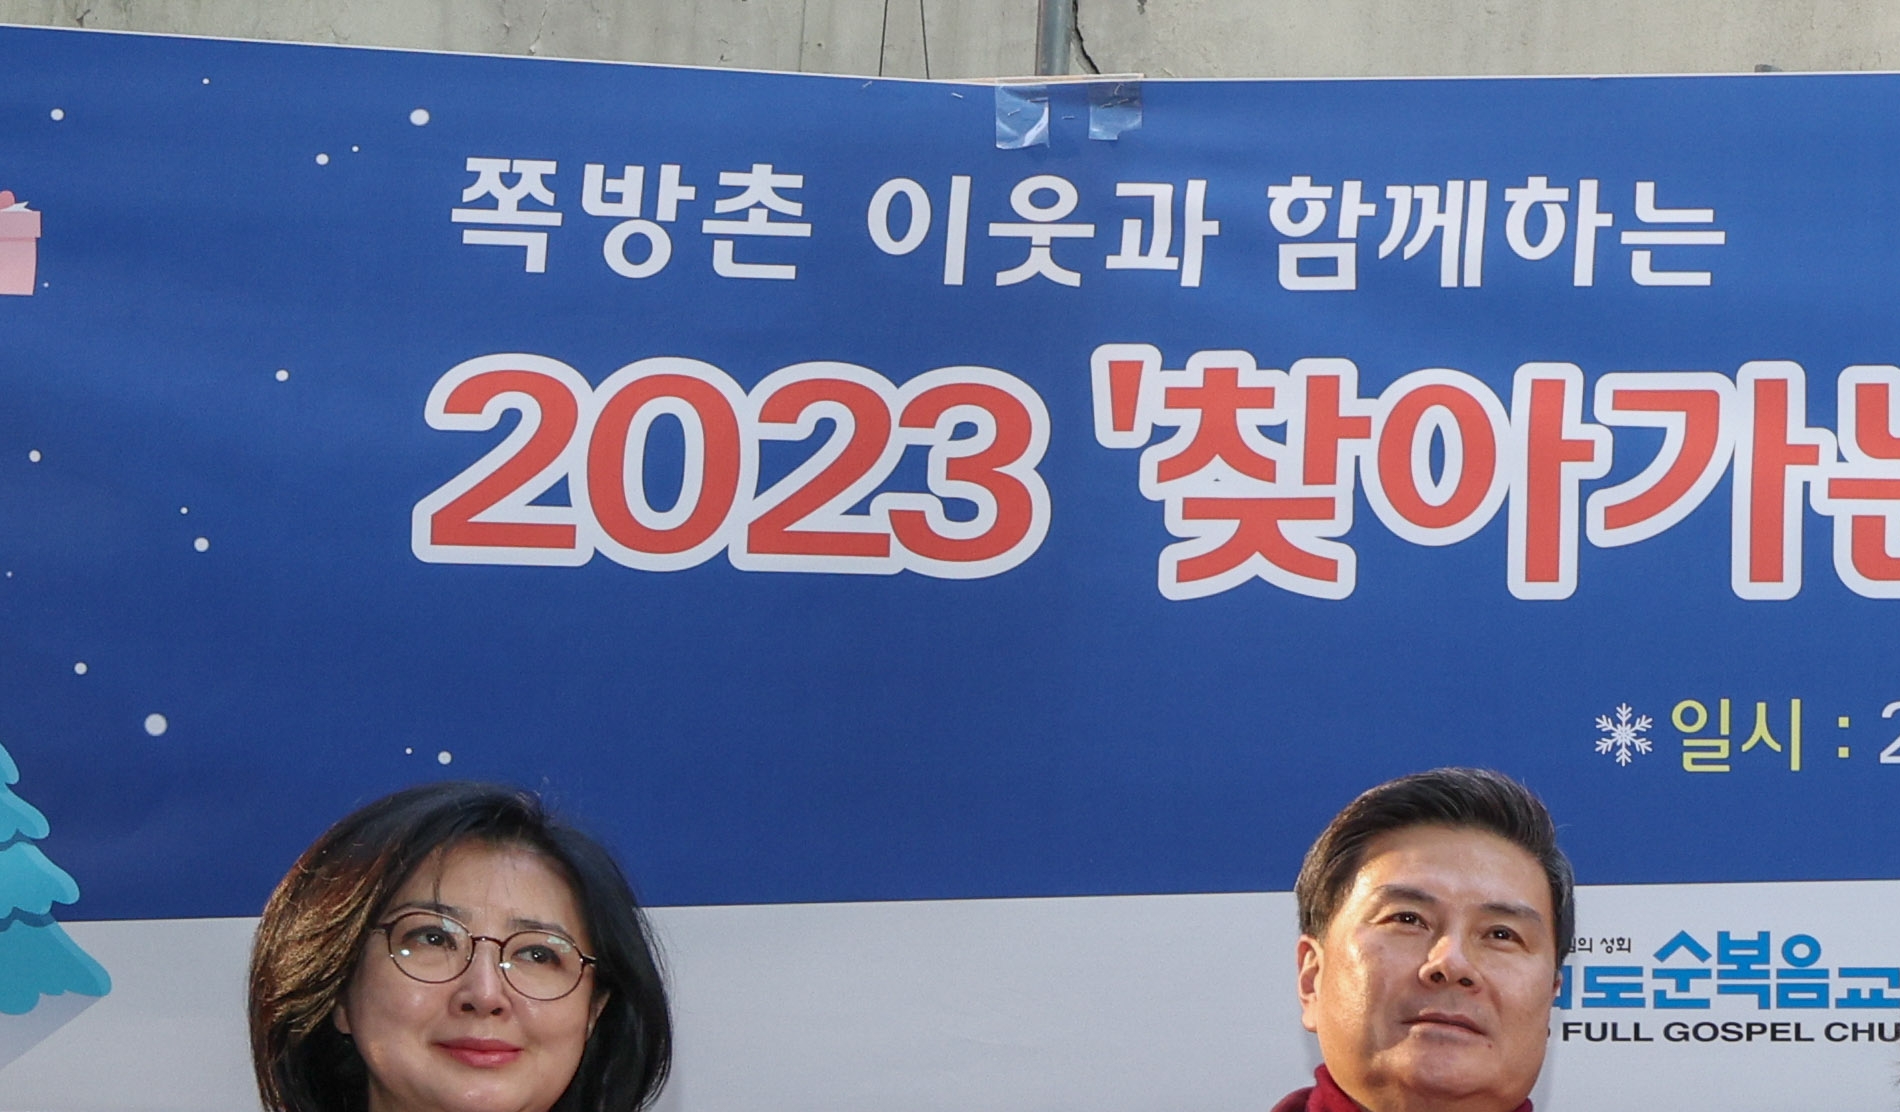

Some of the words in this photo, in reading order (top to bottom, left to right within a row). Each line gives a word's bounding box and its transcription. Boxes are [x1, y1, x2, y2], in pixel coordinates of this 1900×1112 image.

[452, 158, 811, 279] 쪽방촌
[868, 175, 1219, 287] 이웃과
[1268, 176, 1725, 290] 함께하는
[412, 353, 1051, 579] 2023
[1672, 699, 1800, 771] 일시
[1600, 936, 1632, 955] 성회
[1563, 1022, 1653, 1041] FULL
[1664, 1022, 1814, 1042] GOSPEL
